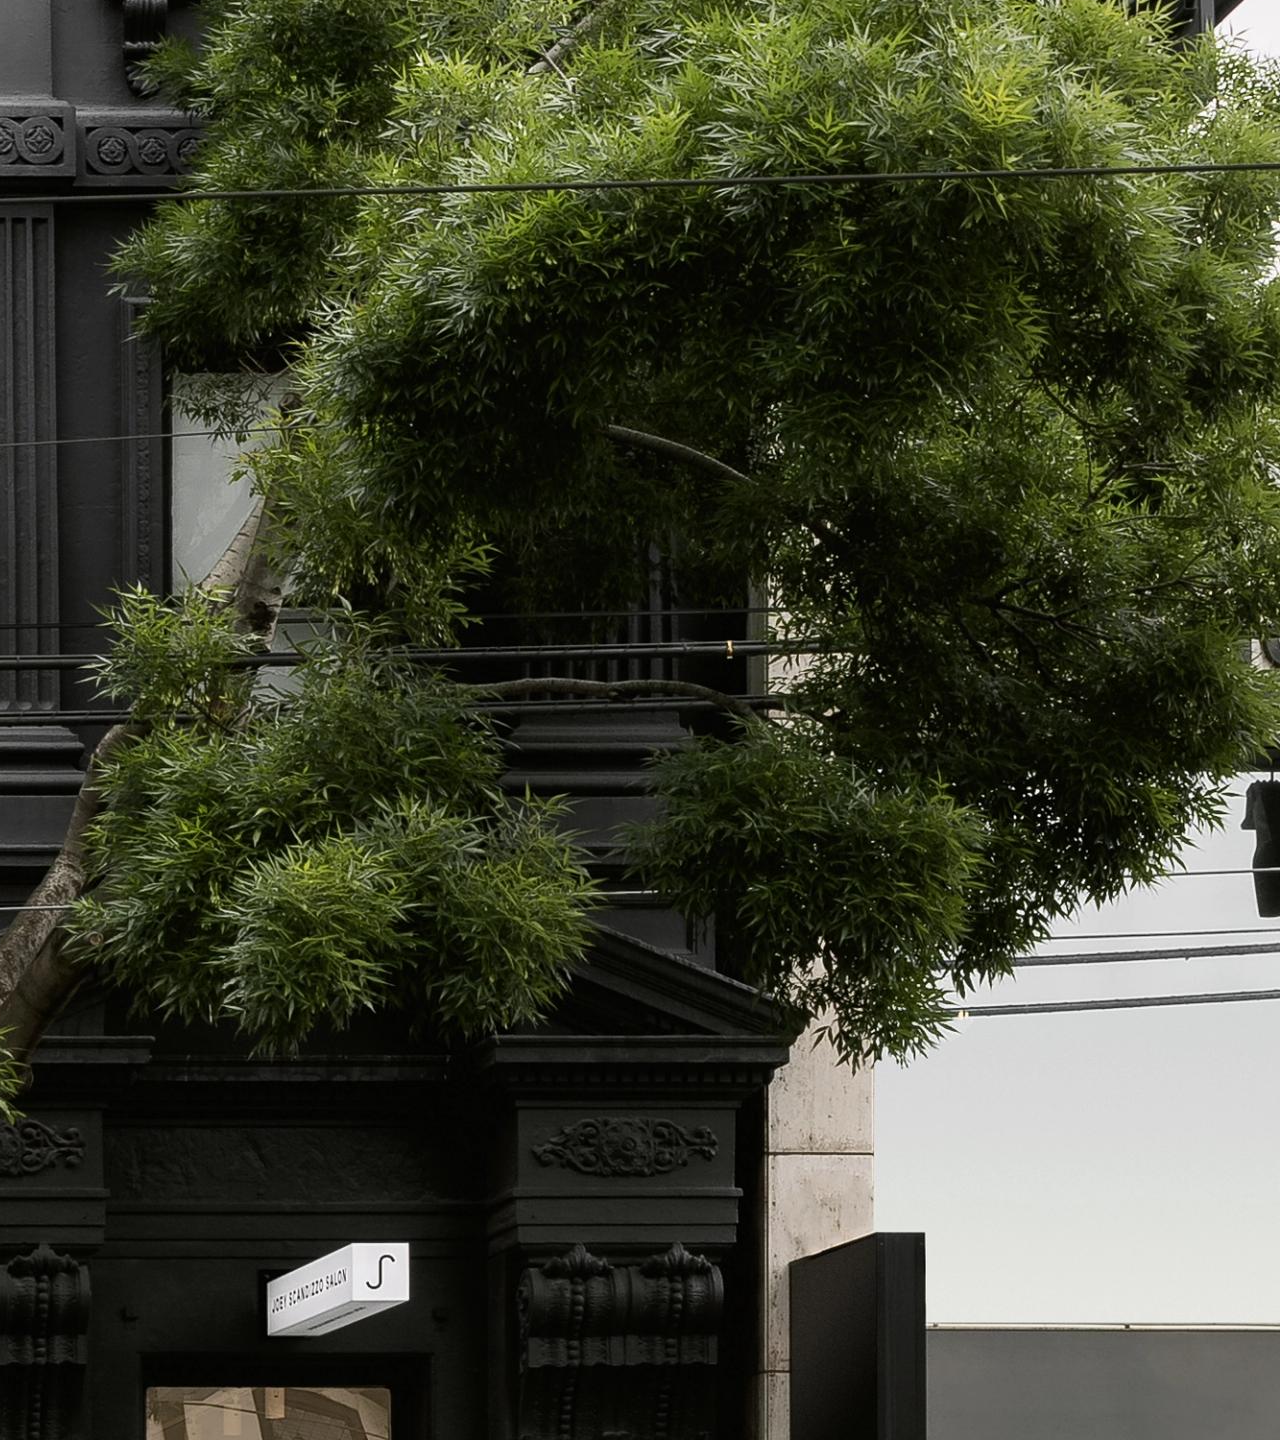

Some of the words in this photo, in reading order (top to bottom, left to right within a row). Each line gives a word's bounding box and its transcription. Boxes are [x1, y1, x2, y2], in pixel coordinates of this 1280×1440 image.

[272, 1294, 287, 1314] JOEY
[288, 1277, 324, 1306] SCANDIZZO
[325, 1268, 348, 1290] SALON
